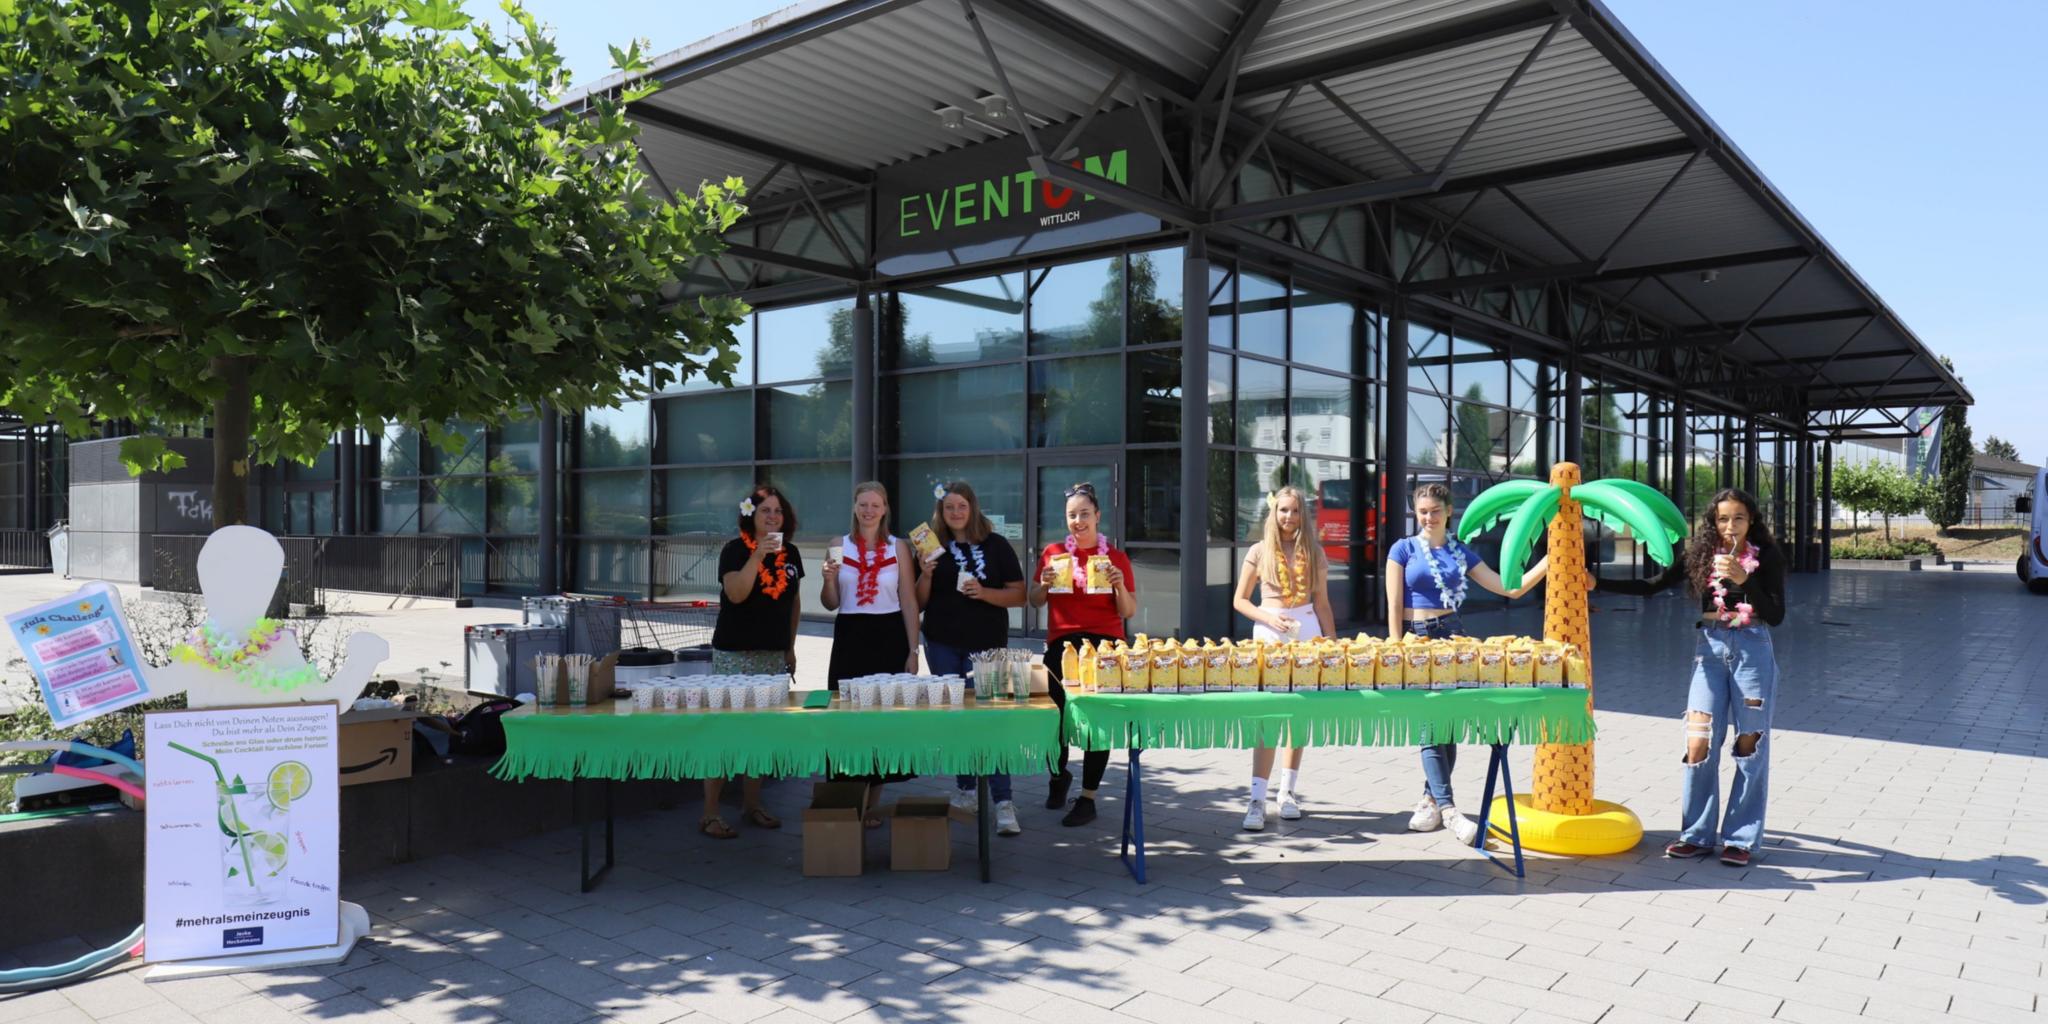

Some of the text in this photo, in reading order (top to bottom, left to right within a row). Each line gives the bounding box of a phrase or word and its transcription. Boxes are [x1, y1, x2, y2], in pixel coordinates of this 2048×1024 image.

[1040, 210, 1080, 227] WITTLICH
[48, 604, 105, 621] Challenge
[174, 719, 193, 728] Dich
[195, 717, 215, 727] nicht
[212, 728, 224, 736] Du
[242, 725, 263, 734] mehr
[265, 724, 275, 733] als
[277, 724, 296, 732] Dein
[175, 907, 311, 928] #mehralsmeinzeugnis
